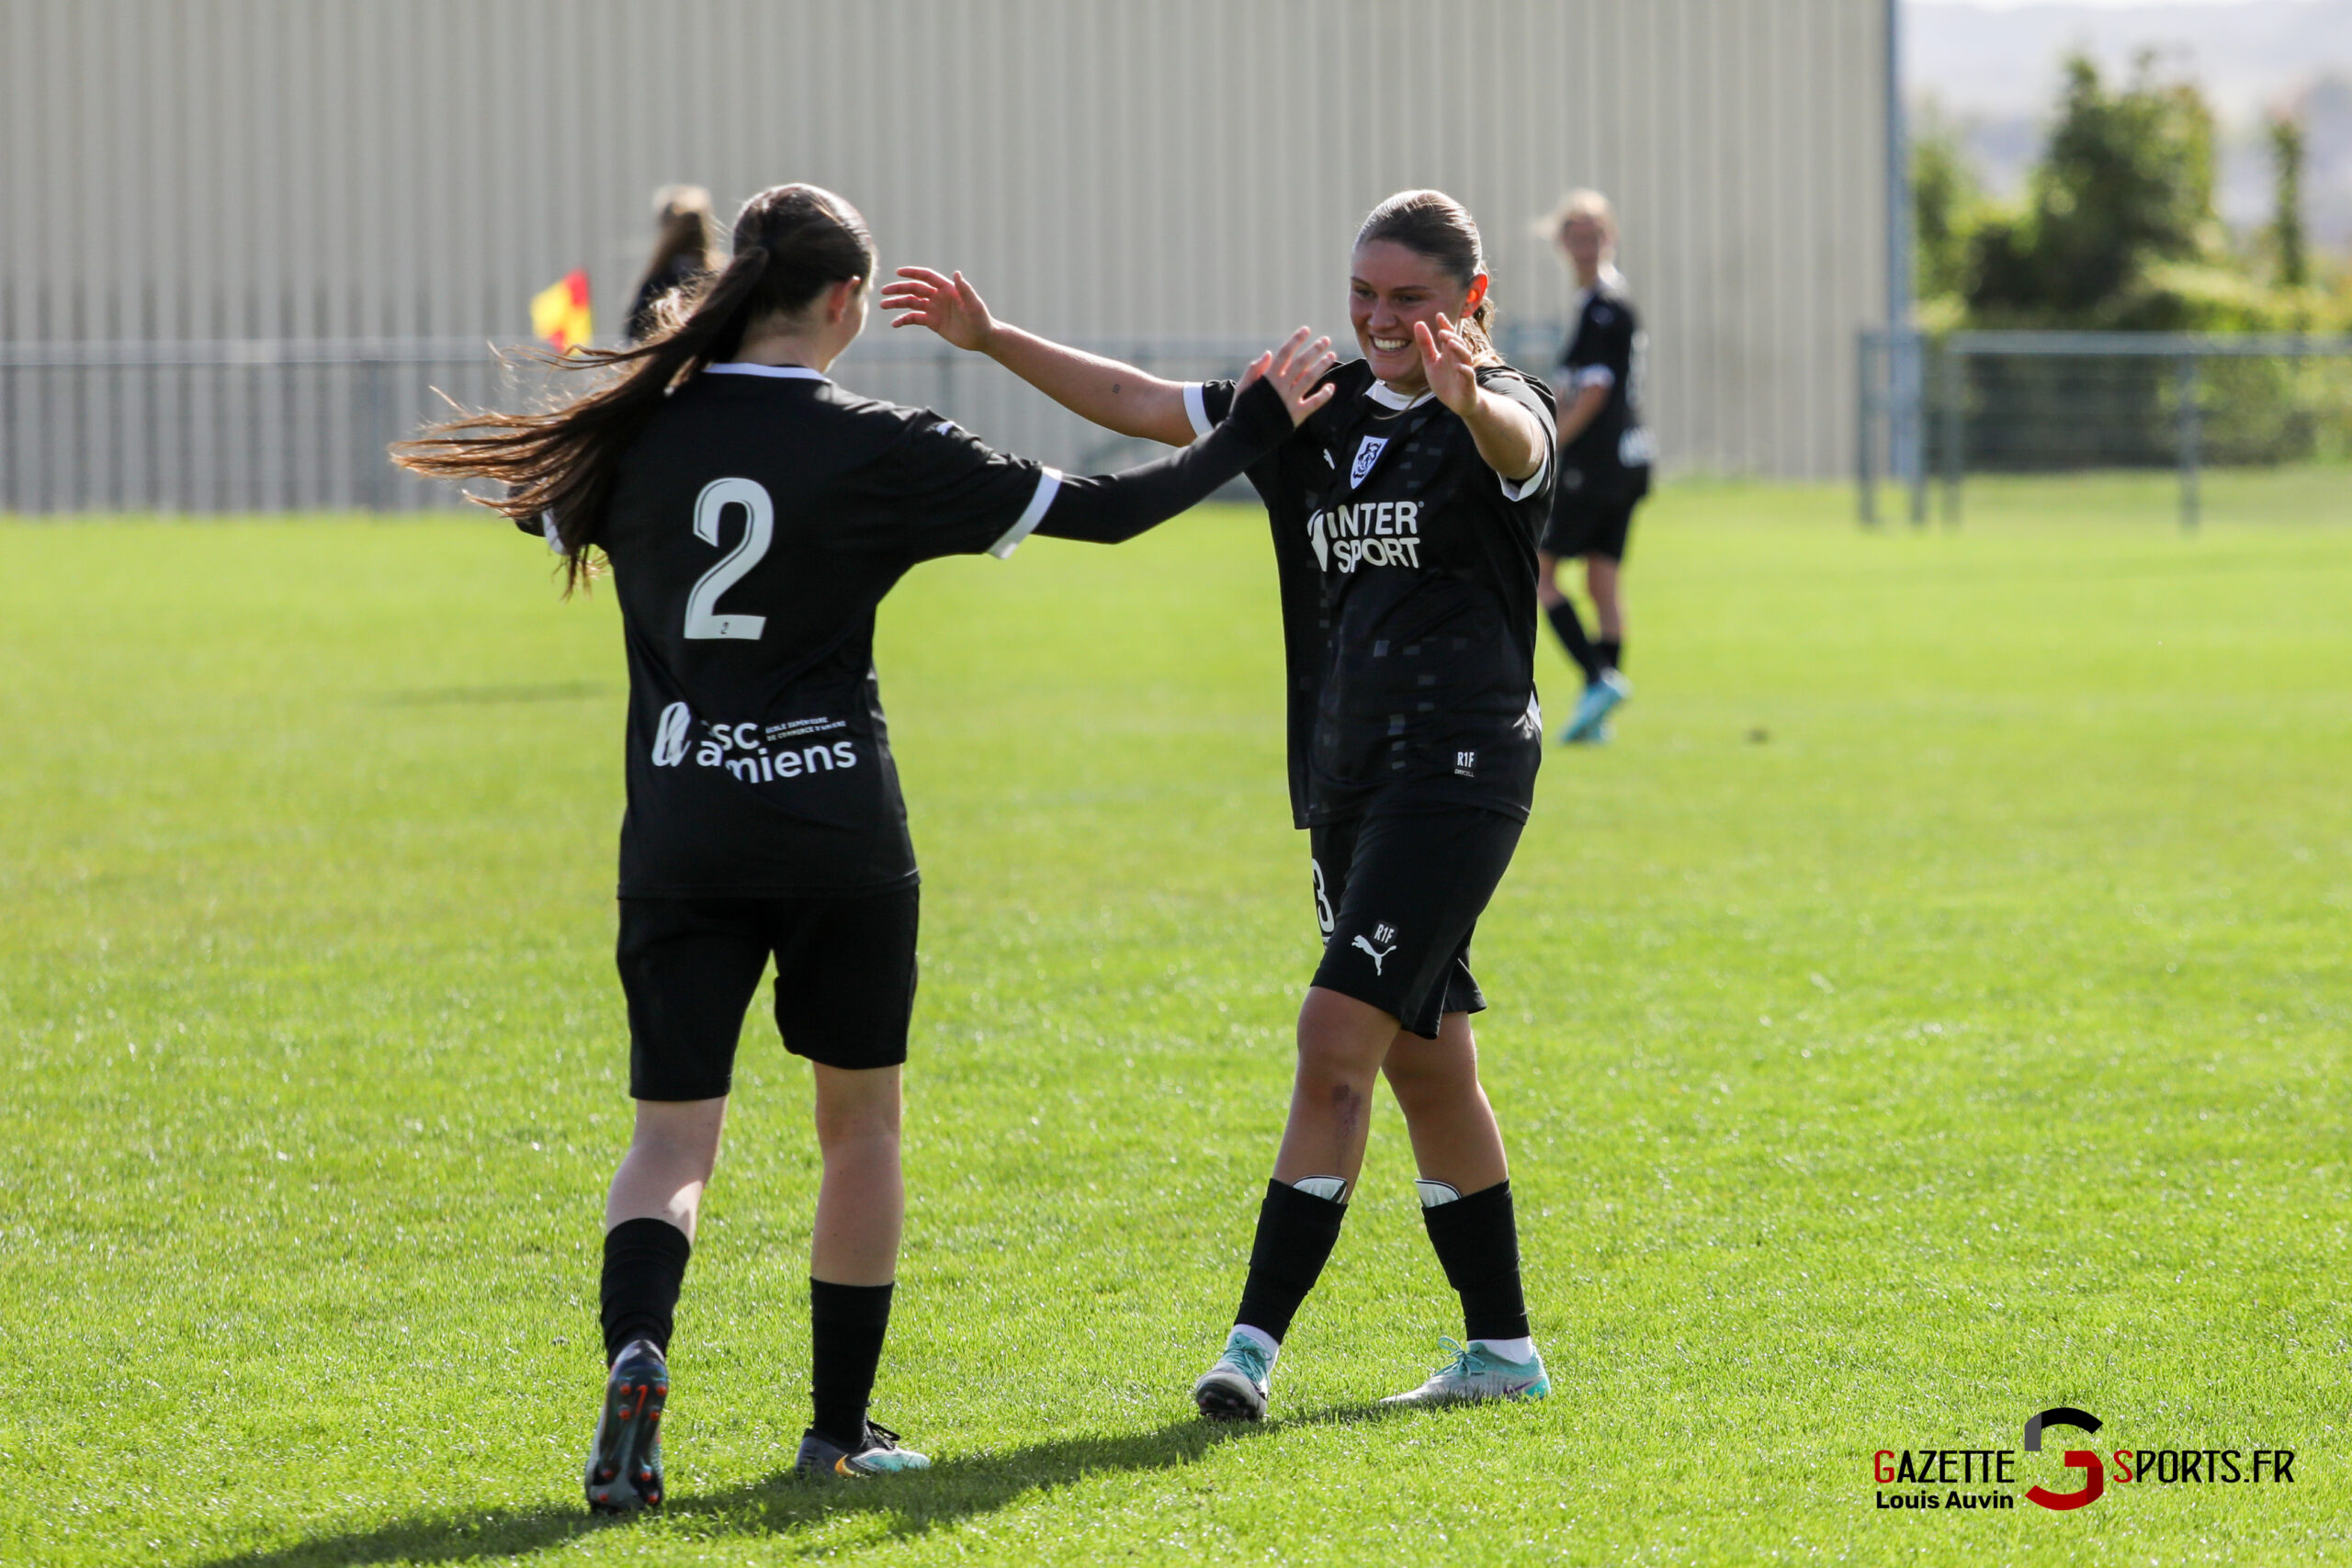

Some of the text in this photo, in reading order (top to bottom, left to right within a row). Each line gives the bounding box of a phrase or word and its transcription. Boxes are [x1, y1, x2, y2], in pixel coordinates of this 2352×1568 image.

[1327, 502, 1419, 538] INTER
[684, 478, 775, 640] 2
[1333, 537, 1420, 574] SPORT
[695, 740, 857, 784] amiens
[1457, 751, 1475, 768] R1F
[1374, 923, 1395, 943] R1F
